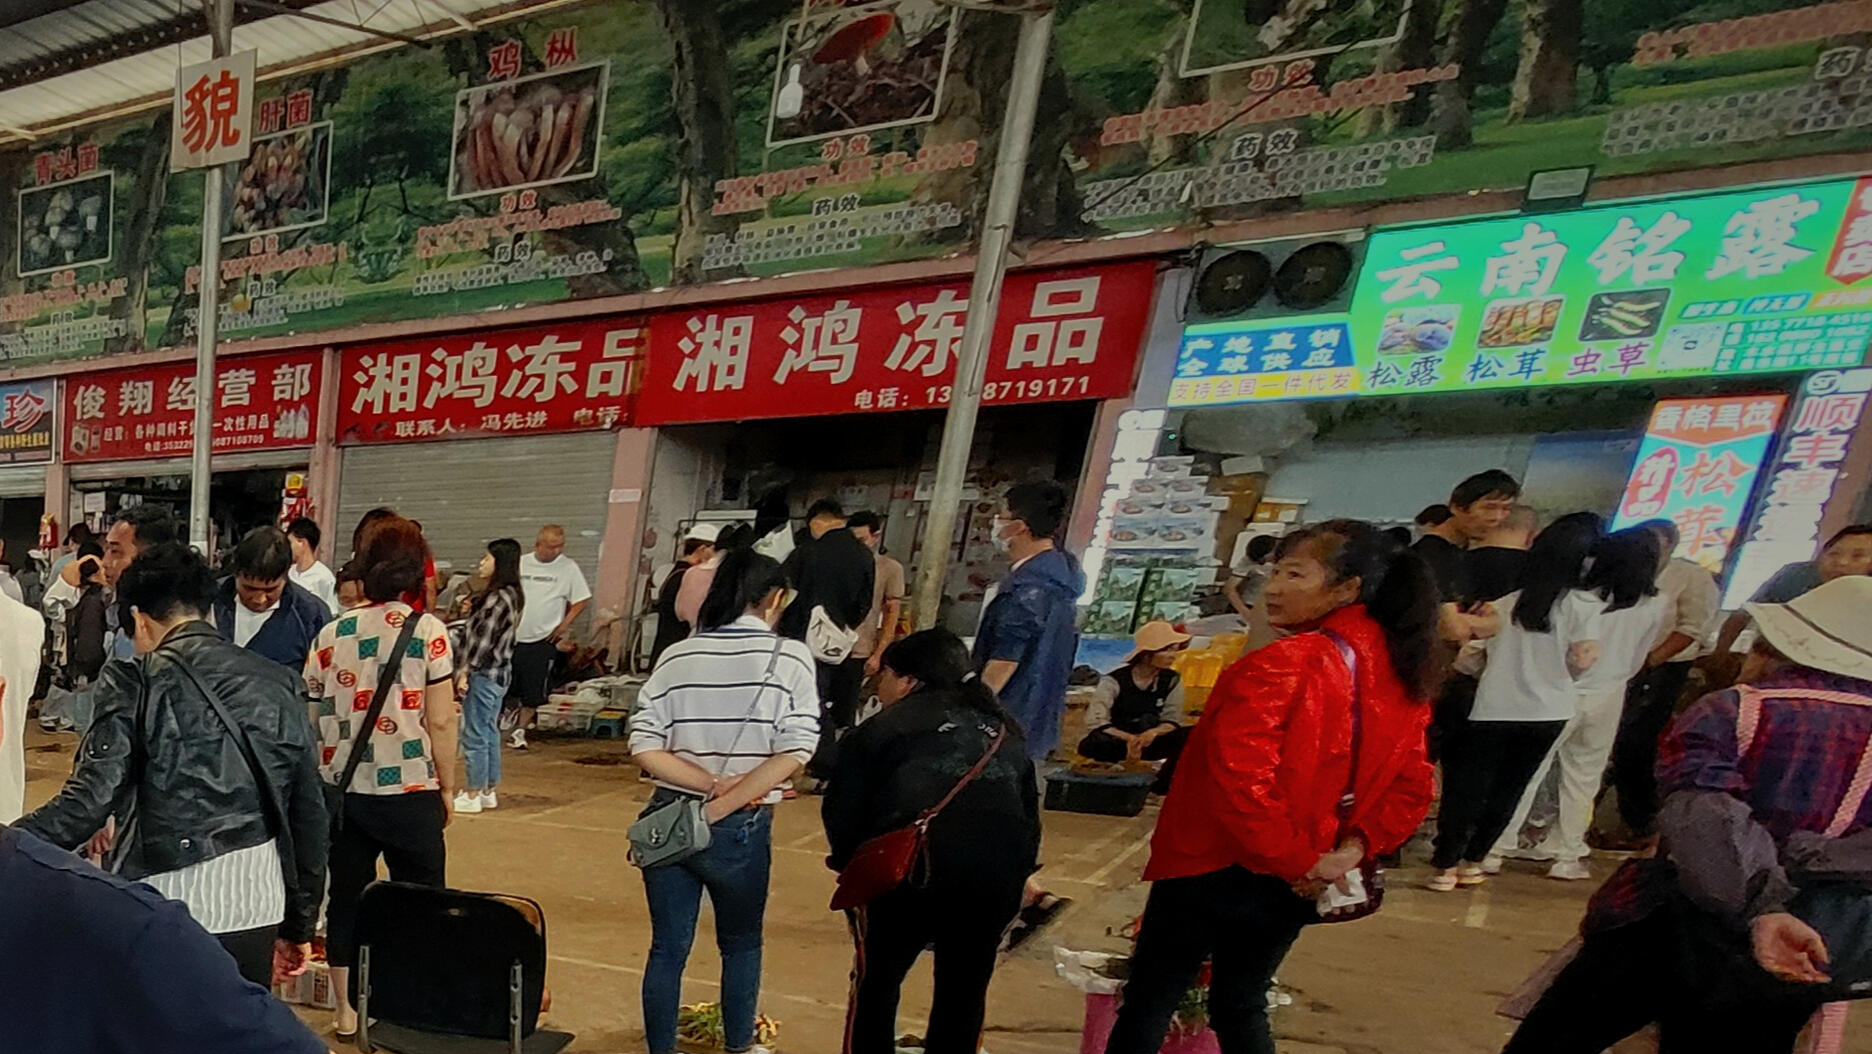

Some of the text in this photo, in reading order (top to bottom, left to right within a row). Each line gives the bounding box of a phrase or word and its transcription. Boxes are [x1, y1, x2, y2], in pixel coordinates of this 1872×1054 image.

[1815, 43, 1872, 79] 药
[182, 70, 240, 155] 貌
[1232, 129, 1299, 159] 药效
[813, 193, 860, 216] 药效
[1375, 192, 1821, 303] 云南铭露
[673, 276, 1104, 393] 湘鸿冻品
[351, 328, 639, 414] 湘鸿冻品
[1178, 348, 1335, 377] 全球供应
[1368, 356, 1443, 388] 松露
[1469, 350, 1546, 382] 松茸
[1568, 342, 1649, 376] 虫草
[73, 363, 312, 420] 俊翔经营部
[1177, 373, 1352, 400] 支持全国一件代发
[1653, 401, 1775, 434] 香格里拉
